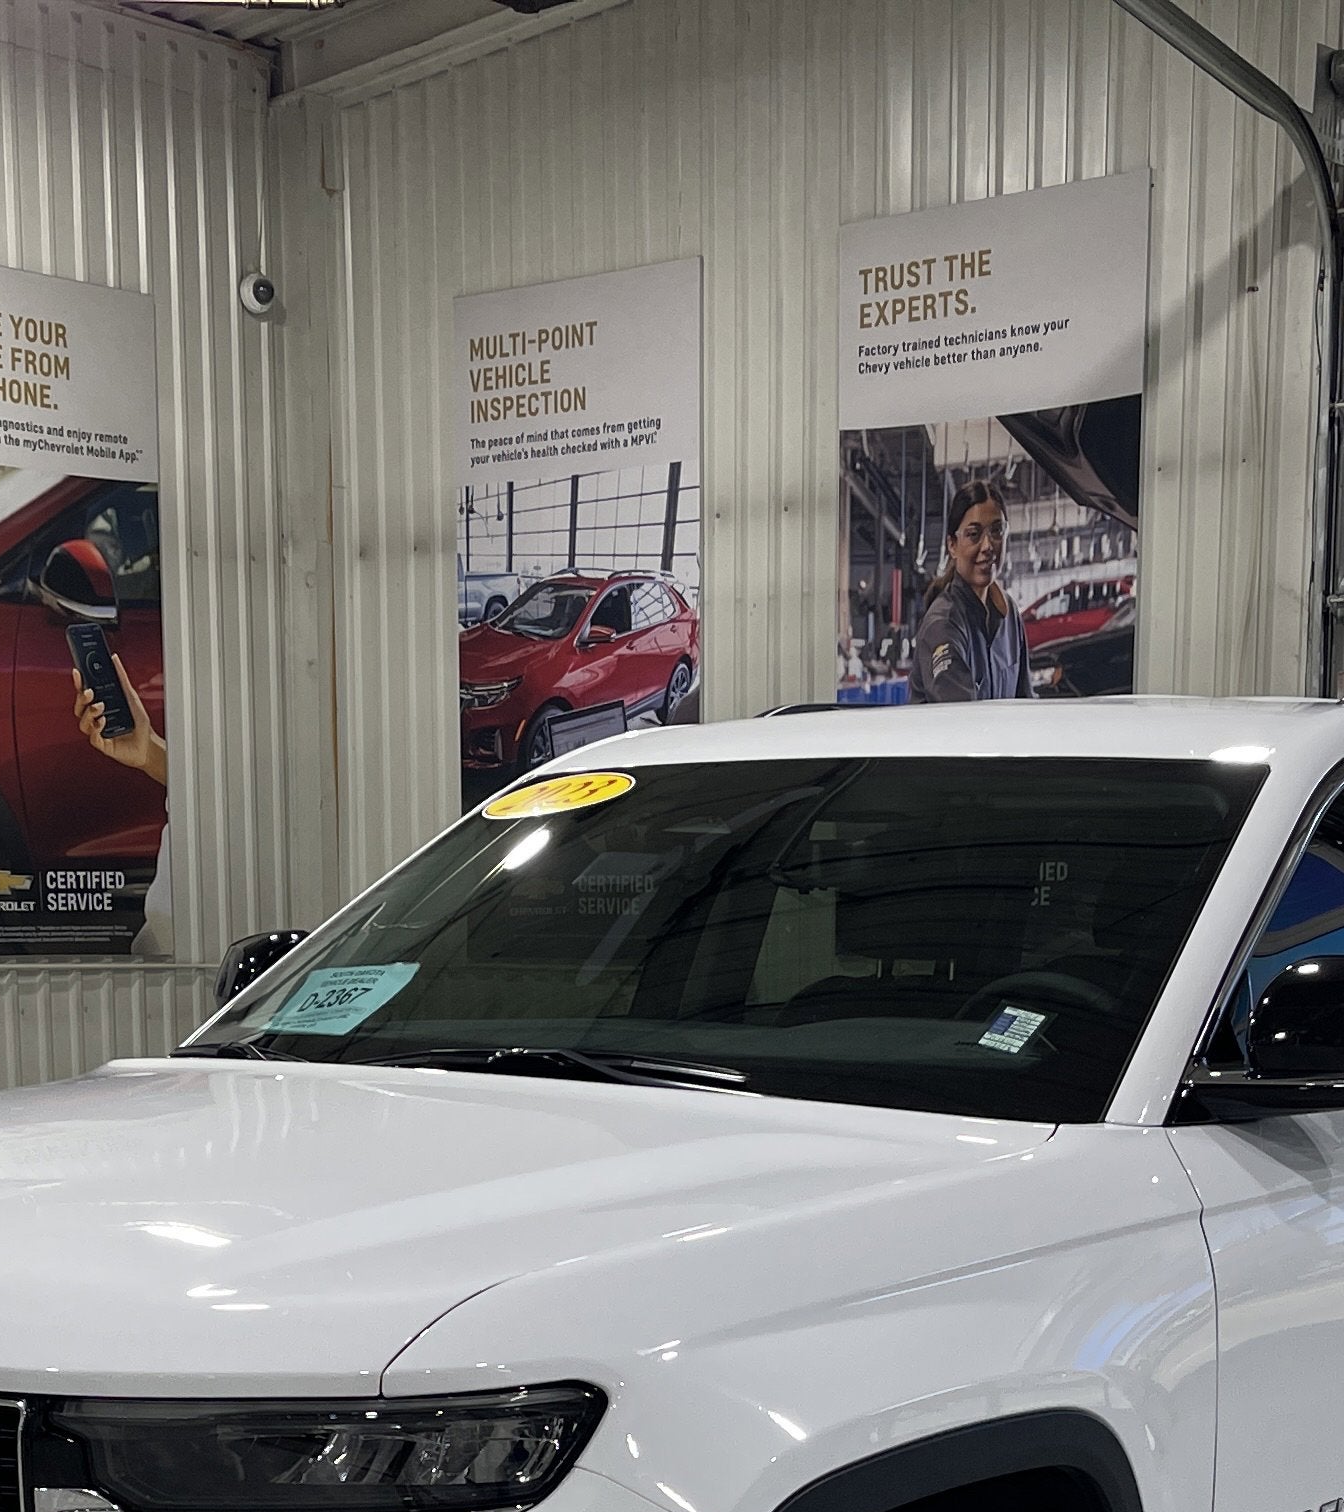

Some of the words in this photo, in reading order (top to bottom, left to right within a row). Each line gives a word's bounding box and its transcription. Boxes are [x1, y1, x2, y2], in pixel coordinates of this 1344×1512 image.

[859, 257, 936, 295] TRUST
[944, 248, 992, 282] THE
[859, 288, 977, 329] EXPERTS.
[8, 313, 68, 348] YOUR
[469, 321, 598, 362] MULTI-POINT
[858, 343, 899, 358] Factory
[902, 335, 940, 352] trained
[944, 327, 1007, 346] technicians
[1010, 324, 1040, 338] know
[1042, 318, 1070, 336] your
[11, 347, 70, 380] FROM
[858, 360, 890, 375] Chevy
[893, 355, 930, 371] vehicle
[933, 351, 968, 366] better
[971, 347, 996, 361] than
[999, 341, 1043, 359] anyone.
[469, 359, 551, 393] VEHICLE
[470, 386, 586, 424] INSPECTION
[4, 434, 20, 447] the
[23, 438, 84, 456] myChevrolet
[86, 445, 116, 459] Mobile
[46, 425, 64, 437] and
[66, 428, 92, 443] enjoy
[94, 433, 128, 444] remote
[470, 437, 486, 449] The
[488, 436, 513, 450] peace
[515, 432, 524, 444] of
[526, 429, 548, 443] mind
[550, 429, 569, 441] that
[571, 425, 600, 438] comes
[602, 422, 625, 434] from
[627, 416, 661, 434] getting
[470, 454, 490, 468] your
[492, 447, 528, 463] vehicle's
[530, 445, 559, 458] health
[561, 440, 597, 456] checked
[600, 437, 621, 450] with
[623, 439, 628, 448] a
[46, 871, 125, 889] CERTIFIED
[47, 893, 113, 911] SERVICE
[578, 898, 641, 915] SERVICE
[296, 987, 373, 1012] D-2367
